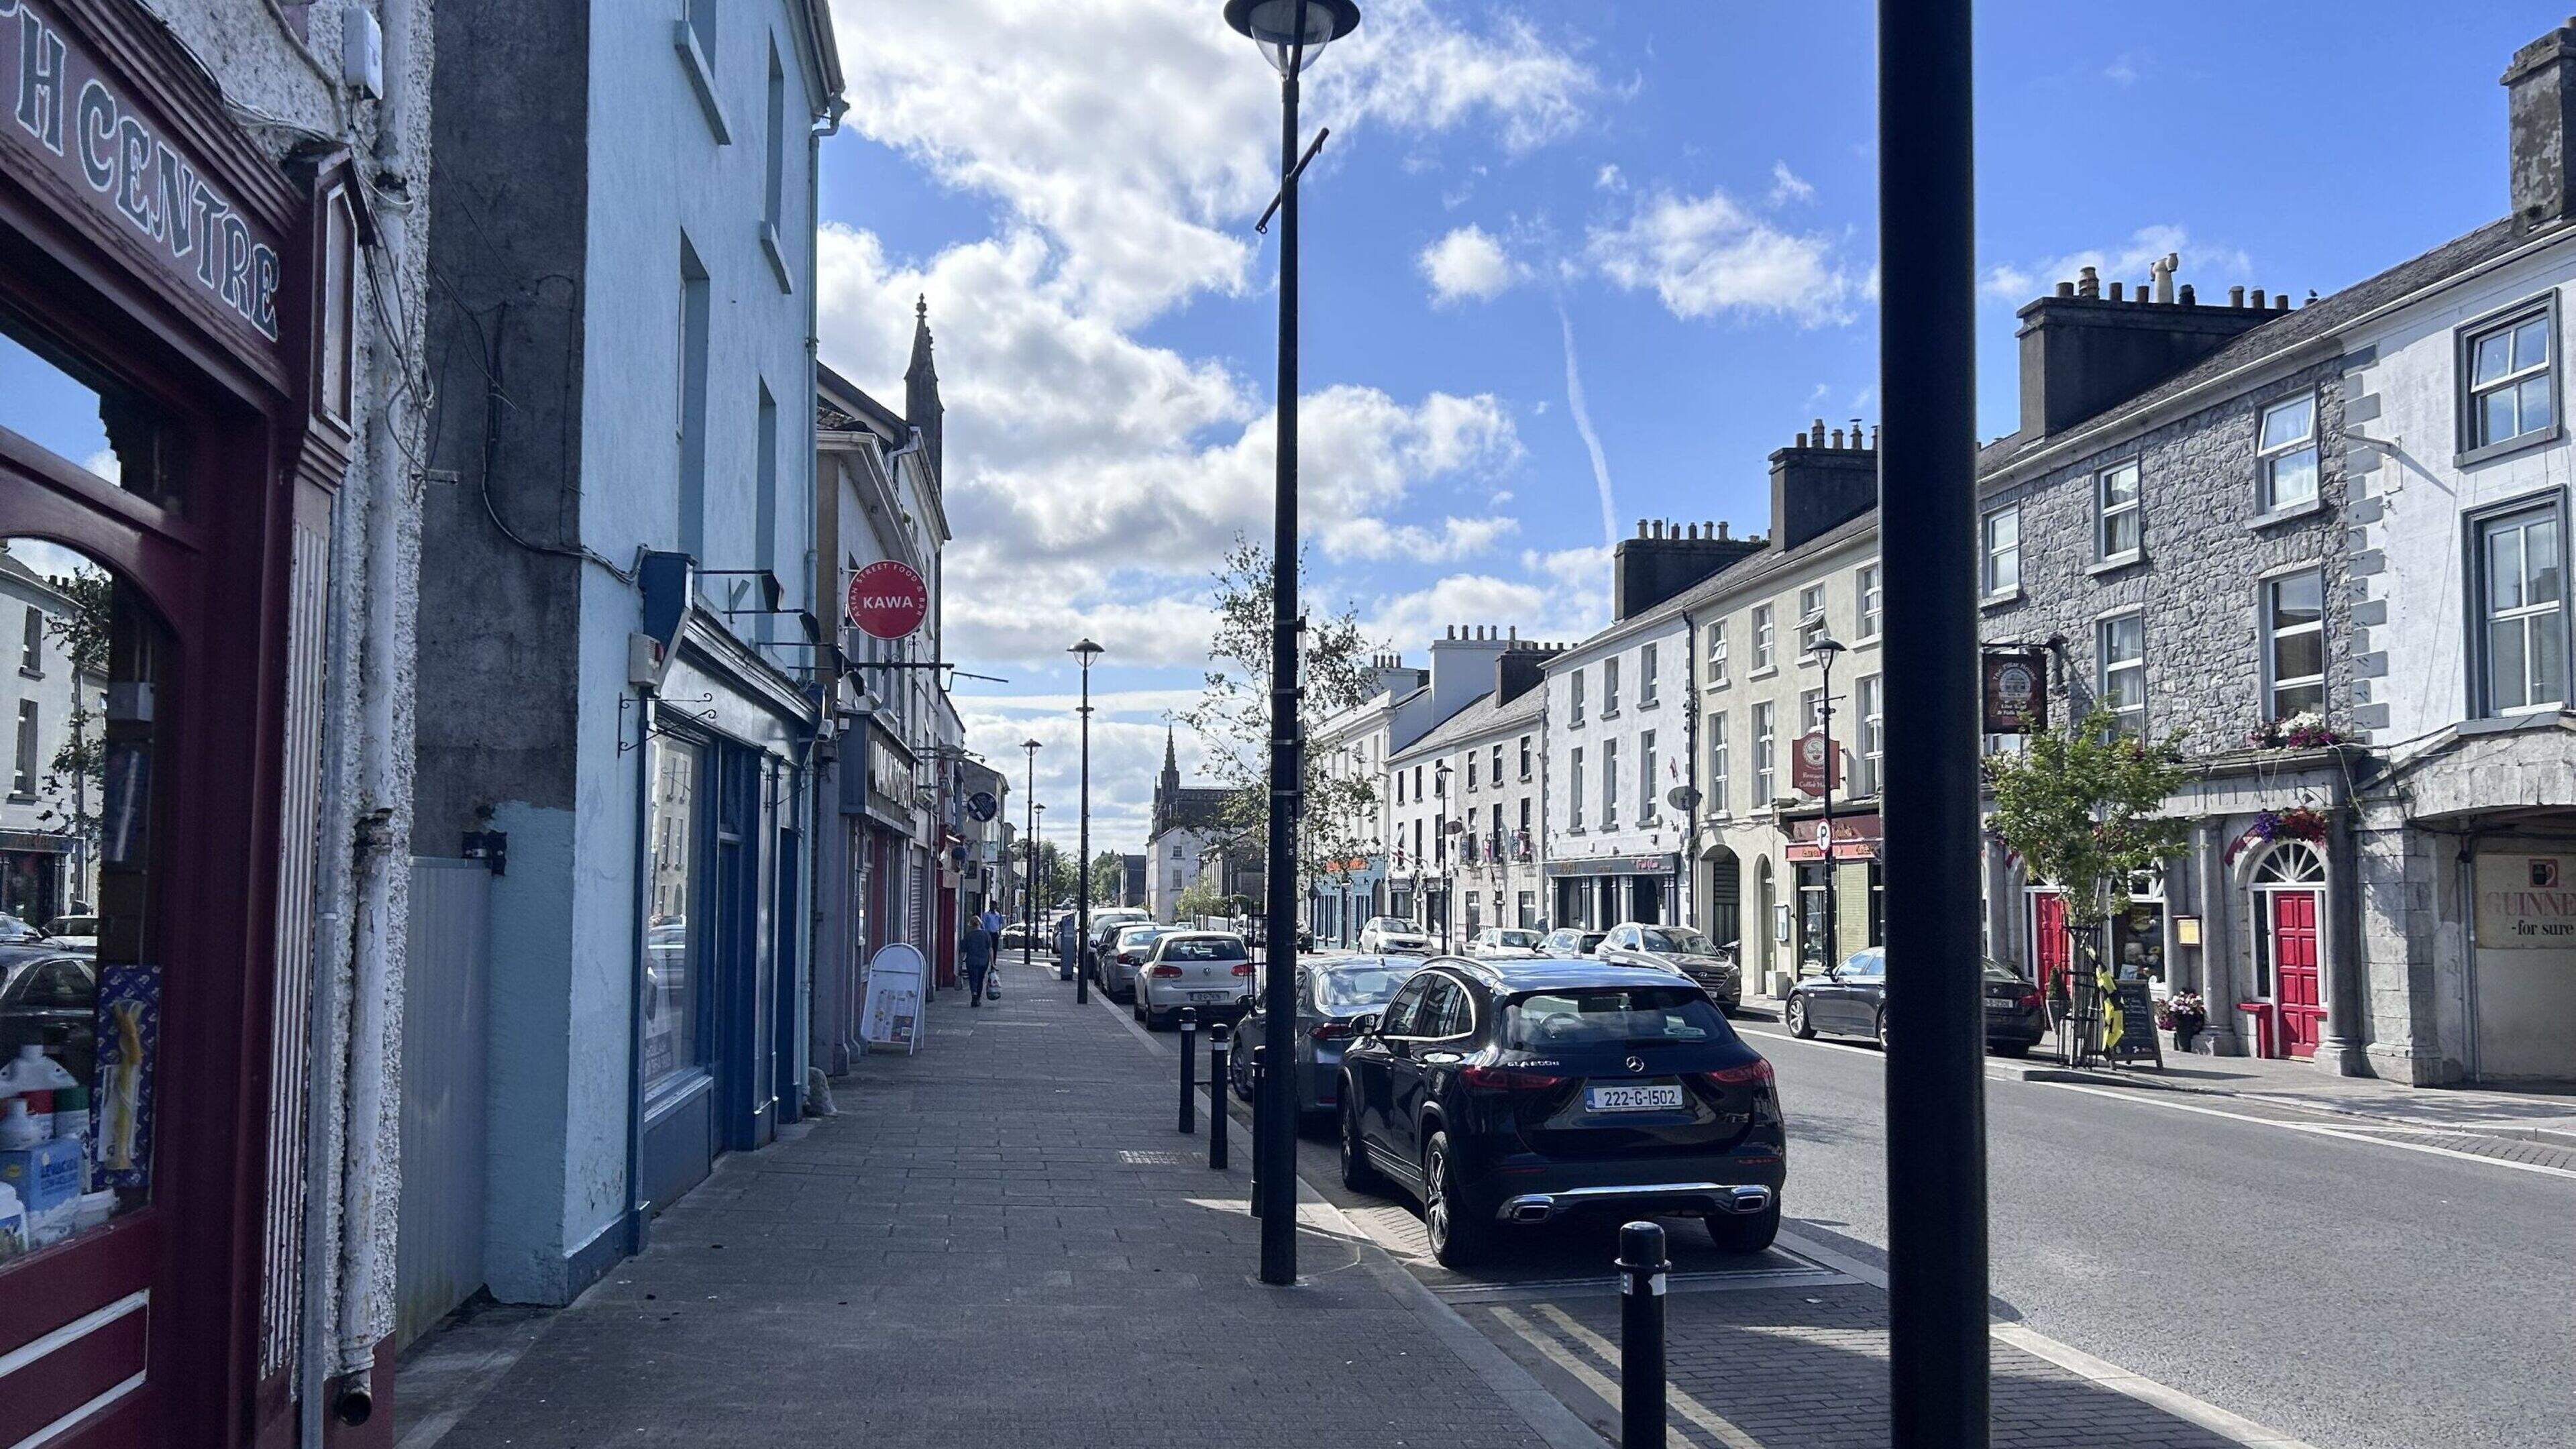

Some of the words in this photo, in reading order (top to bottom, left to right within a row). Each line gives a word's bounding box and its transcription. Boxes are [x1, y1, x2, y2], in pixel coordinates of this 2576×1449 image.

[0, 0, 66, 156] H
[77, 78, 279, 343] CENTRE
[851, 587, 861, 616] ASIAN
[856, 563, 888, 583] STREET
[893, 564, 918, 582] FOOD
[916, 598, 925, 616] BAR
[863, 596, 913, 609] KAWA
[2541, 923, 2575, 936] sure
[1604, 1089, 1676, 1107] 222-G-1502
